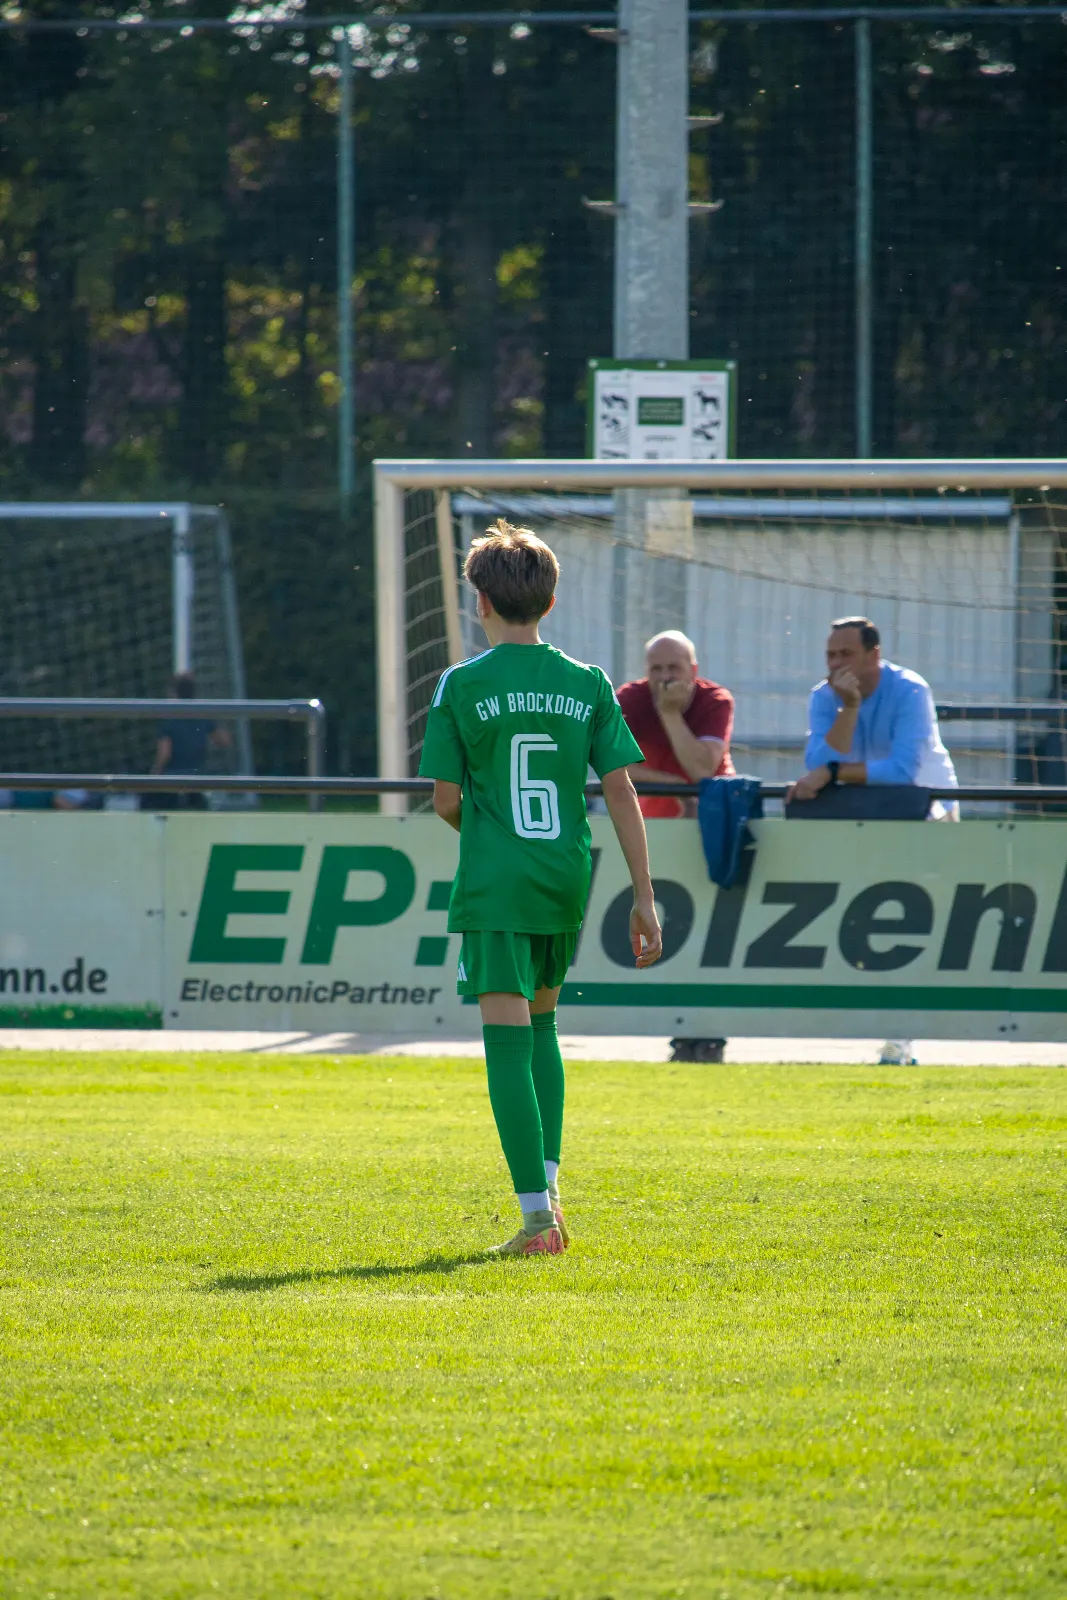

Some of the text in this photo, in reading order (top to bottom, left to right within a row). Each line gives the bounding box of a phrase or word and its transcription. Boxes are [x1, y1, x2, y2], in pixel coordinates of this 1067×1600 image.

[475, 691, 594, 723] GW BROCKDORF
[510, 733, 561, 840] 6
[188, 844, 1067, 972] EP: olzen
[179, 977, 442, 1005] ElectronicPartner
